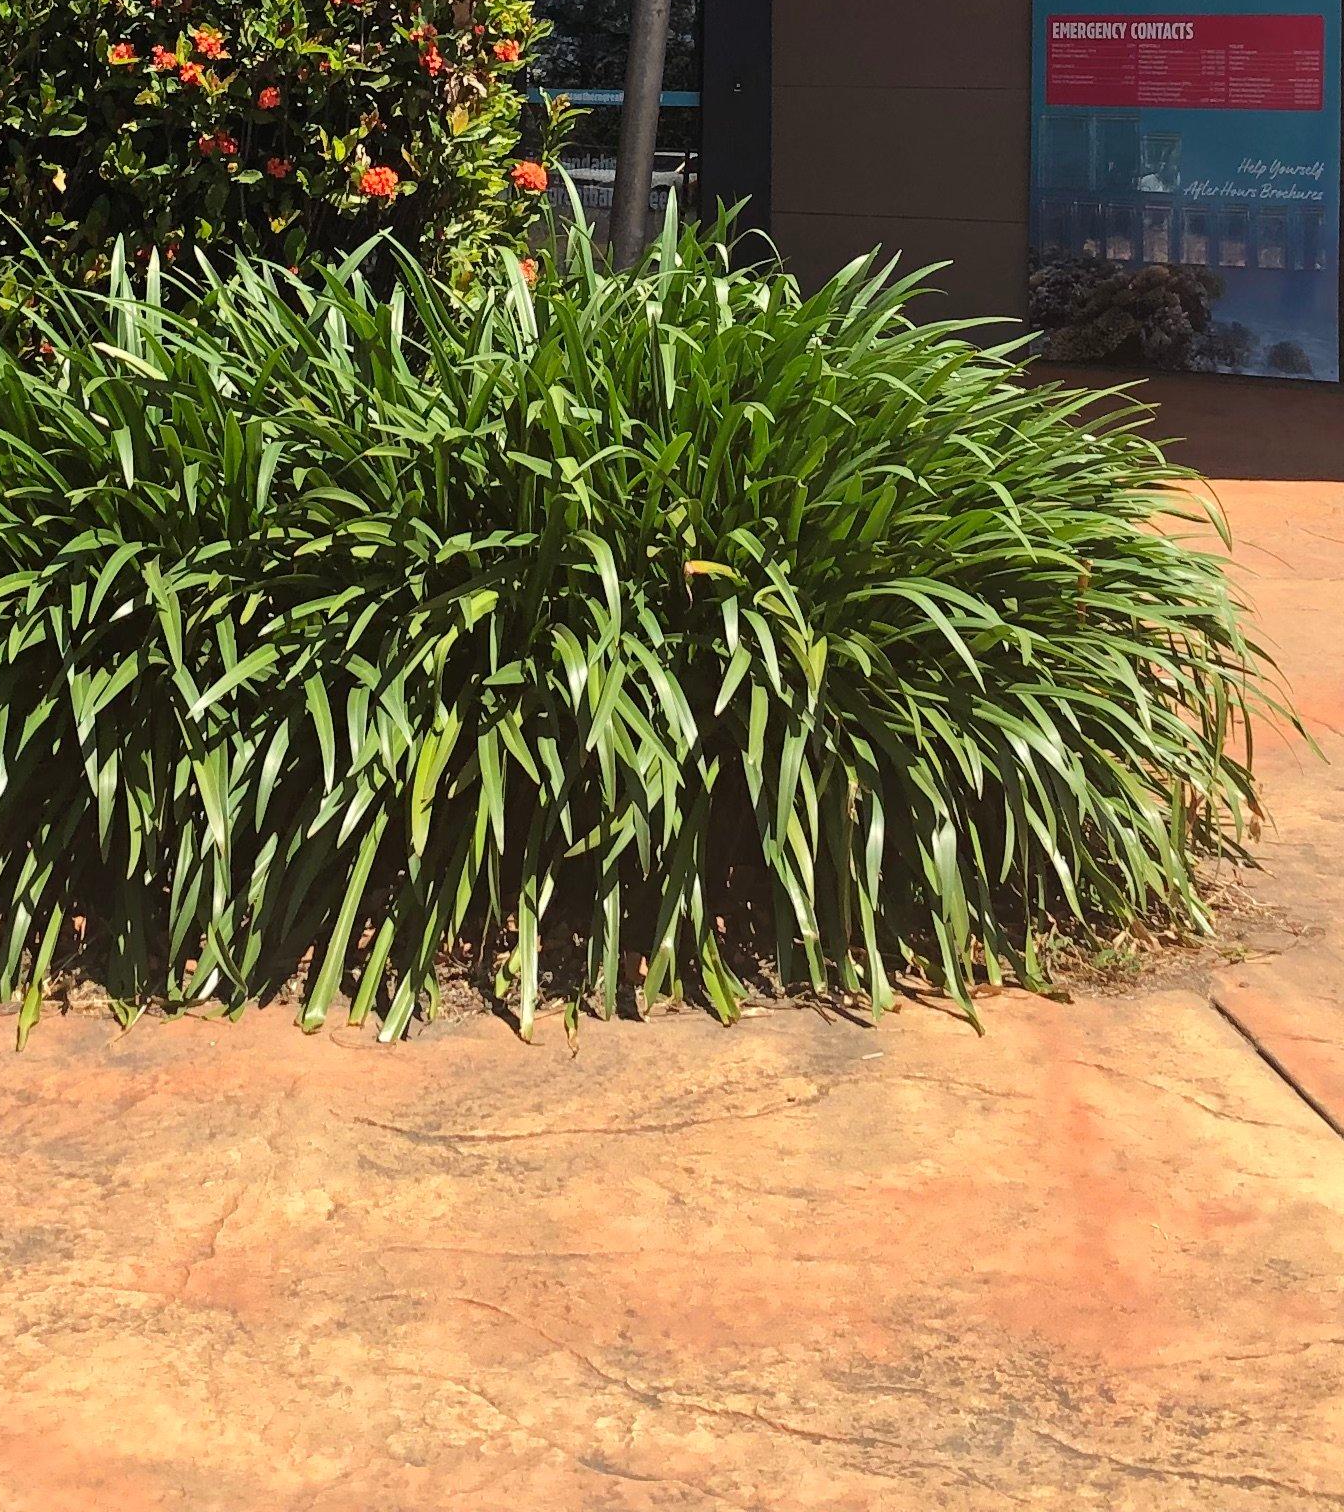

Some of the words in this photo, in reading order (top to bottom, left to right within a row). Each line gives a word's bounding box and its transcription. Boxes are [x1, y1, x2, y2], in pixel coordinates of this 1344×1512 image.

[1052, 22, 1128, 39] EMERGENCY
[1131, 22, 1194, 40] CONTACTS
[1237, 157, 1267, 179] Help
[1269, 158, 1325, 181] Yourself
[1183, 179, 1219, 200] After
[1220, 180, 1257, 198] Hours
[1259, 183, 1324, 201] Brochures
